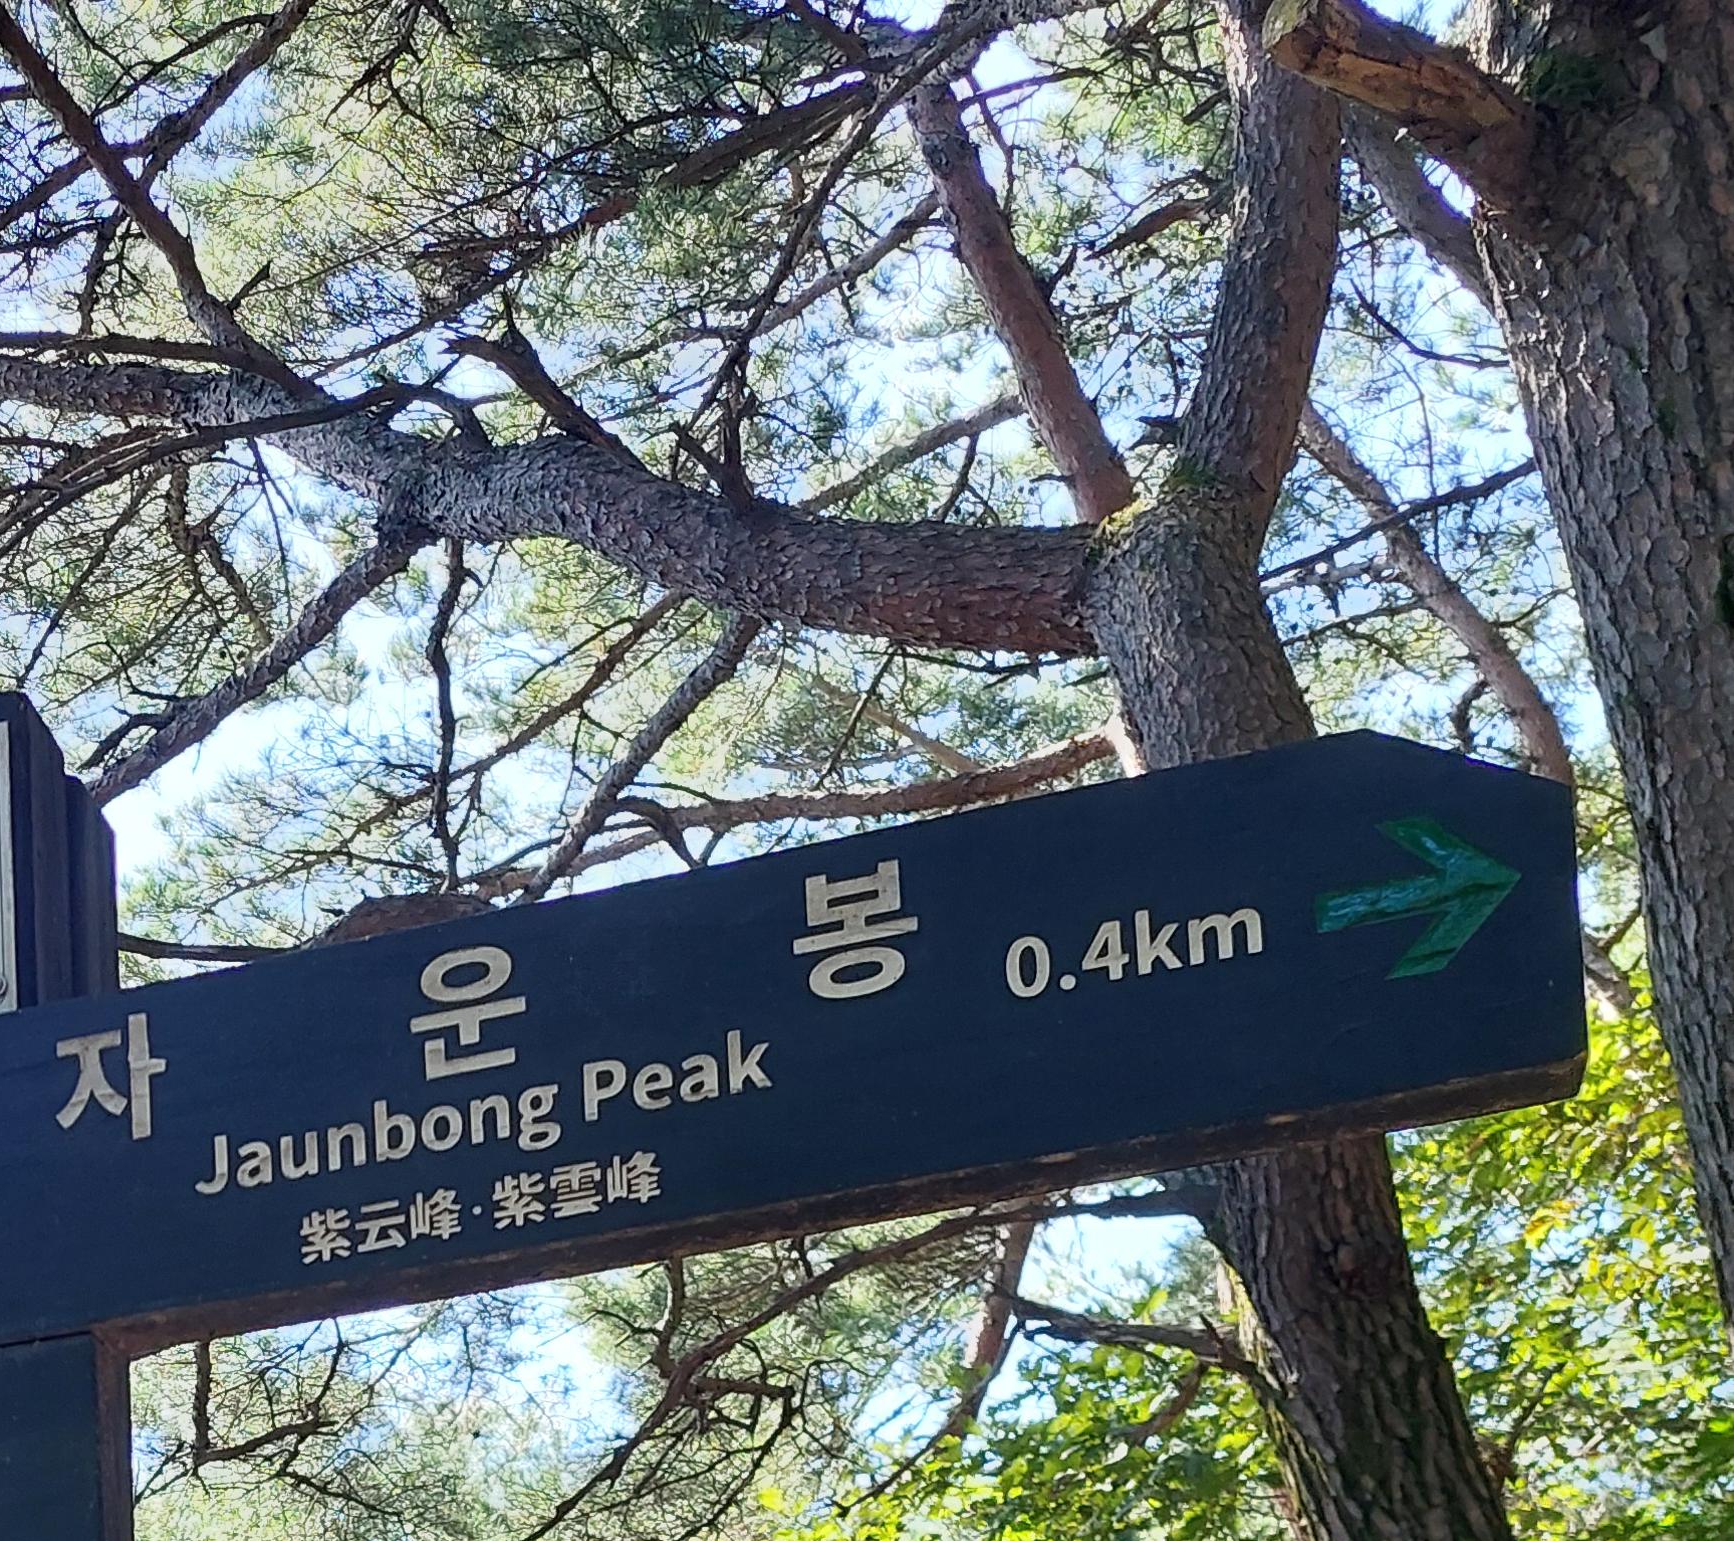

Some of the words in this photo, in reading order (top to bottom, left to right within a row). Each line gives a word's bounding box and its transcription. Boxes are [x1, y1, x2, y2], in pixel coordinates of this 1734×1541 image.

[1004, 905, 1264, 998] 0.4km
[195, 1082, 563, 1195] Jaunbong
[582, 1029, 773, 1122] Peak
